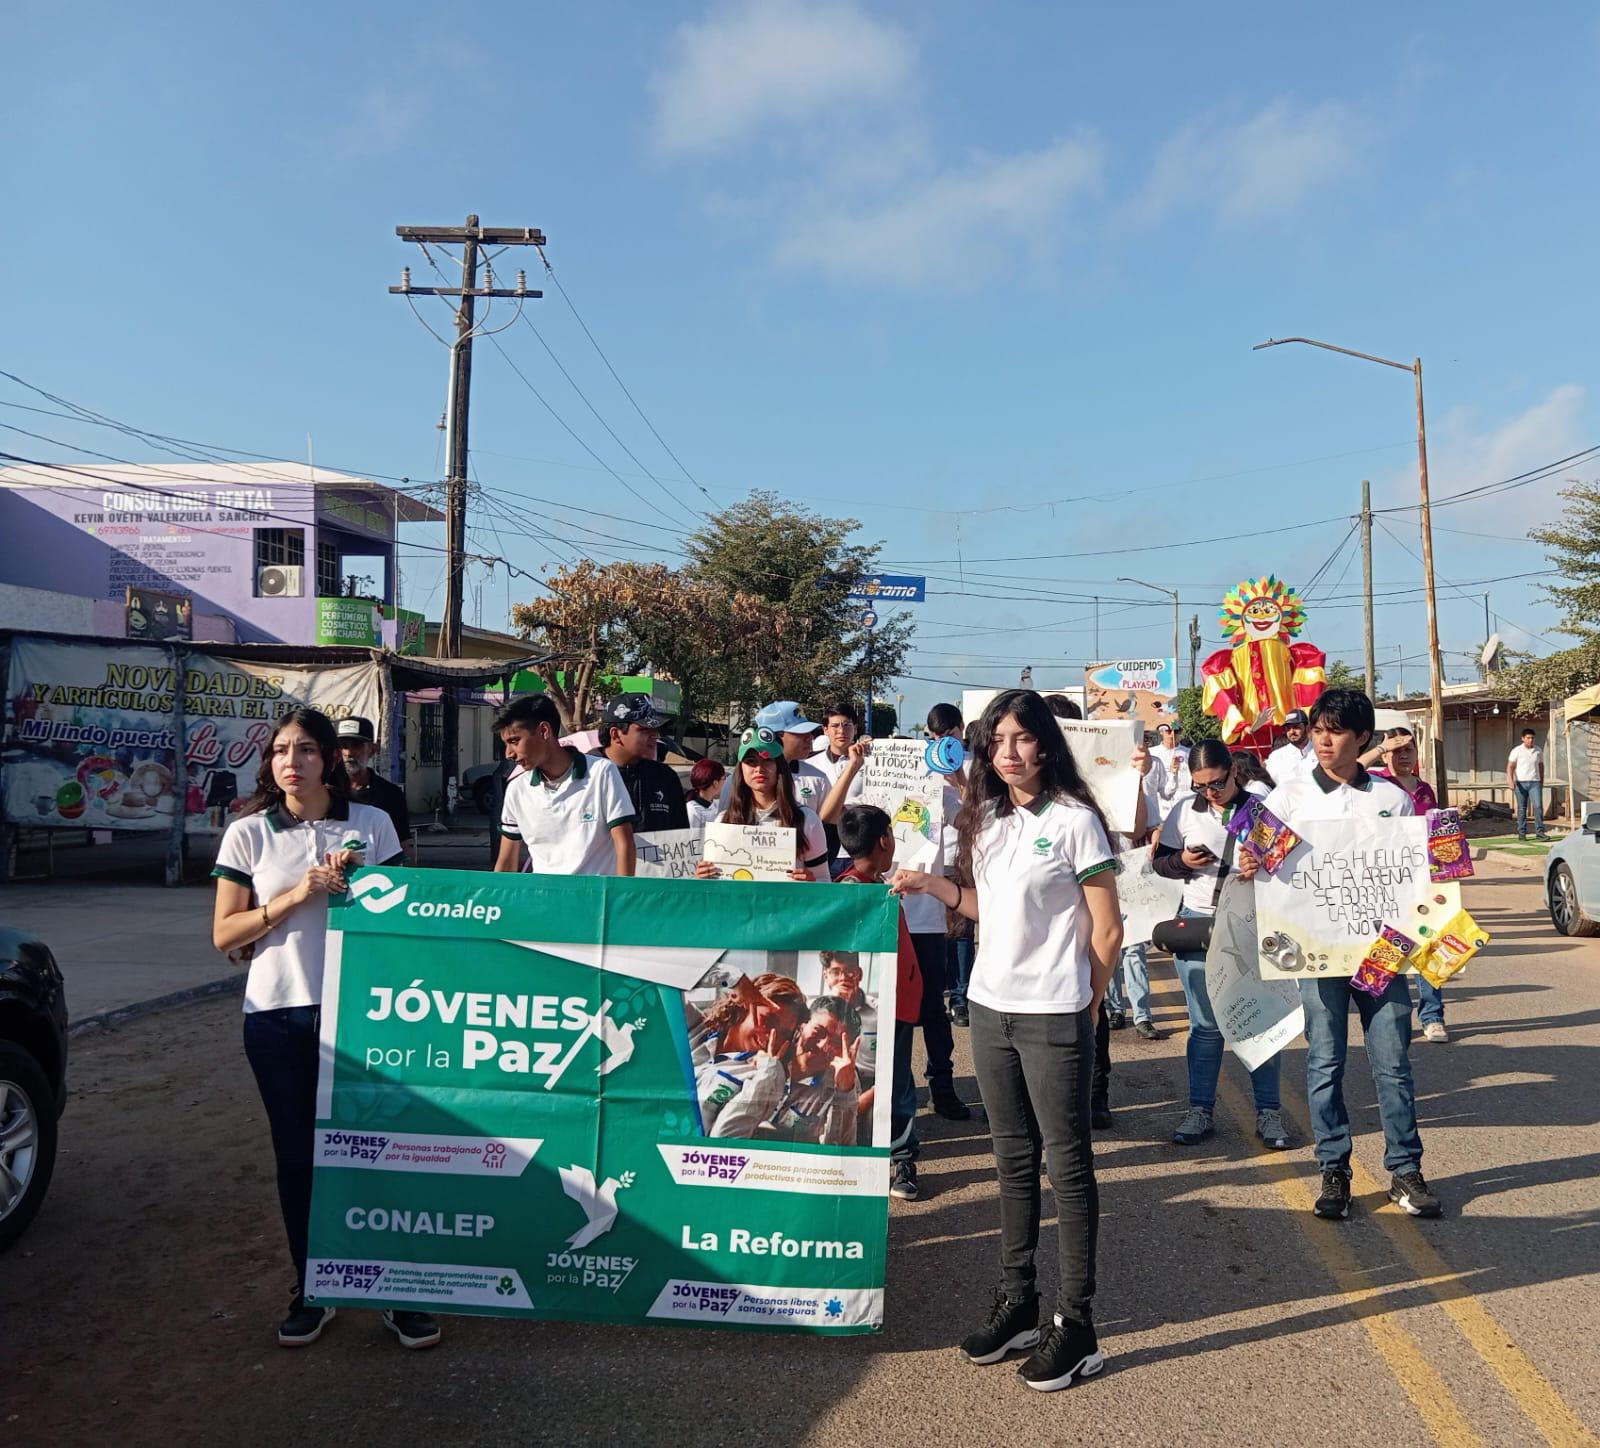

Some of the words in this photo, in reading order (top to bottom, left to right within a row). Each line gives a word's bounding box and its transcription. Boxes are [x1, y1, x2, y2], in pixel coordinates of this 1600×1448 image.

[103, 491, 209, 512] CONSULTORIO
[215, 490, 274, 511] DENTAL
[74, 513, 104, 524] KEVIN
[148, 512, 213, 523] VALENZUELA
[218, 511, 270, 523] SANCHEZ
[321, 612, 367, 621] PERFUMERIA
[321, 621, 368, 631] COSMETICOS
[321, 629, 366, 639] CHACHARAS
[1116, 660, 1164, 672] CUIDEMOS
[1122, 680, 1158, 690] PLAYAS!!
[32, 683, 49, 704] Y
[51, 684, 174, 713] ARTÍCULOS
[240, 700, 268, 719] EL
[272, 702, 352, 720] HAR
[22, 719, 49, 742] Mi
[52, 721, 106, 744] lindo
[185, 721, 222, 765] La
[866, 778, 891, 788] hacen
[752, 836, 776, 847] MAR
[637, 839, 702, 864] TIRAME
[1310, 852, 1348, 872] LAS
[1352, 846, 1425, 870] HUELLAS
[1292, 871, 1320, 889] EN
[1329, 870, 1354, 888] LA
[1361, 866, 1414, 886] ARENA
[1313, 887, 1335, 907] SE
[1340, 886, 1396, 906] BORRAN
[407, 897, 502, 925] conalep
[1329, 905, 1348, 922] LA
[1352, 901, 1401, 920] BASURA
[1347, 920, 1370, 936] NO
[366, 979, 589, 1031] JÓVENES
[366, 1046, 416, 1071] por
[427, 1044, 450, 1068] la
[463, 1029, 563, 1075] Paz
[324, 1131, 386, 1147] JÓVENES
[350, 1146, 377, 1159] Paz
[392, 1143, 431, 1152] Personas
[433, 1145, 482, 1154] trabajando
[385, 1153, 400, 1161] por
[402, 1153, 410, 1161] la
[412, 1153, 451, 1163] igualdad
[681, 1151, 746, 1167] JÓVENES
[708, 1165, 737, 1180] Paz
[753, 1162, 791, 1172] Personas
[793, 1166, 845, 1177] preparadas,
[744, 1173, 795, 1183] productivas
[803, 1177, 858, 1186] innovadoras
[345, 1207, 495, 1238] CONALEP
[681, 1224, 718, 1251] La
[729, 1228, 864, 1260] Reforma
[316, 1261, 381, 1275] JÓVENES
[546, 1250, 634, 1272] JÓVENES
[316, 1279, 330, 1287] por
[332, 1279, 340, 1287] la
[343, 1275, 372, 1288] Paz
[389, 1268, 422, 1277] Personas
[424, 1270, 483, 1280] comprometidas
[547, 1274, 566, 1284] por
[569, 1273, 579, 1284] la
[583, 1269, 622, 1288] Paz
[392, 1277, 436, 1286] comunidad,
[447, 1281, 488, 1289] naturaleza
[418, 1287, 453, 1296] ambiente
[672, 1283, 738, 1300] JÓVENES
[672, 1301, 686, 1309] por
[689, 1301, 697, 1309] la
[700, 1298, 728, 1312] Paz
[743, 1295, 788, 1306] Personas
[791, 1298, 819, 1308] libres,
[737, 1305, 767, 1313] sanas
[768, 1307, 775, 1315] y
[777, 1307, 816, 1316] seguras
